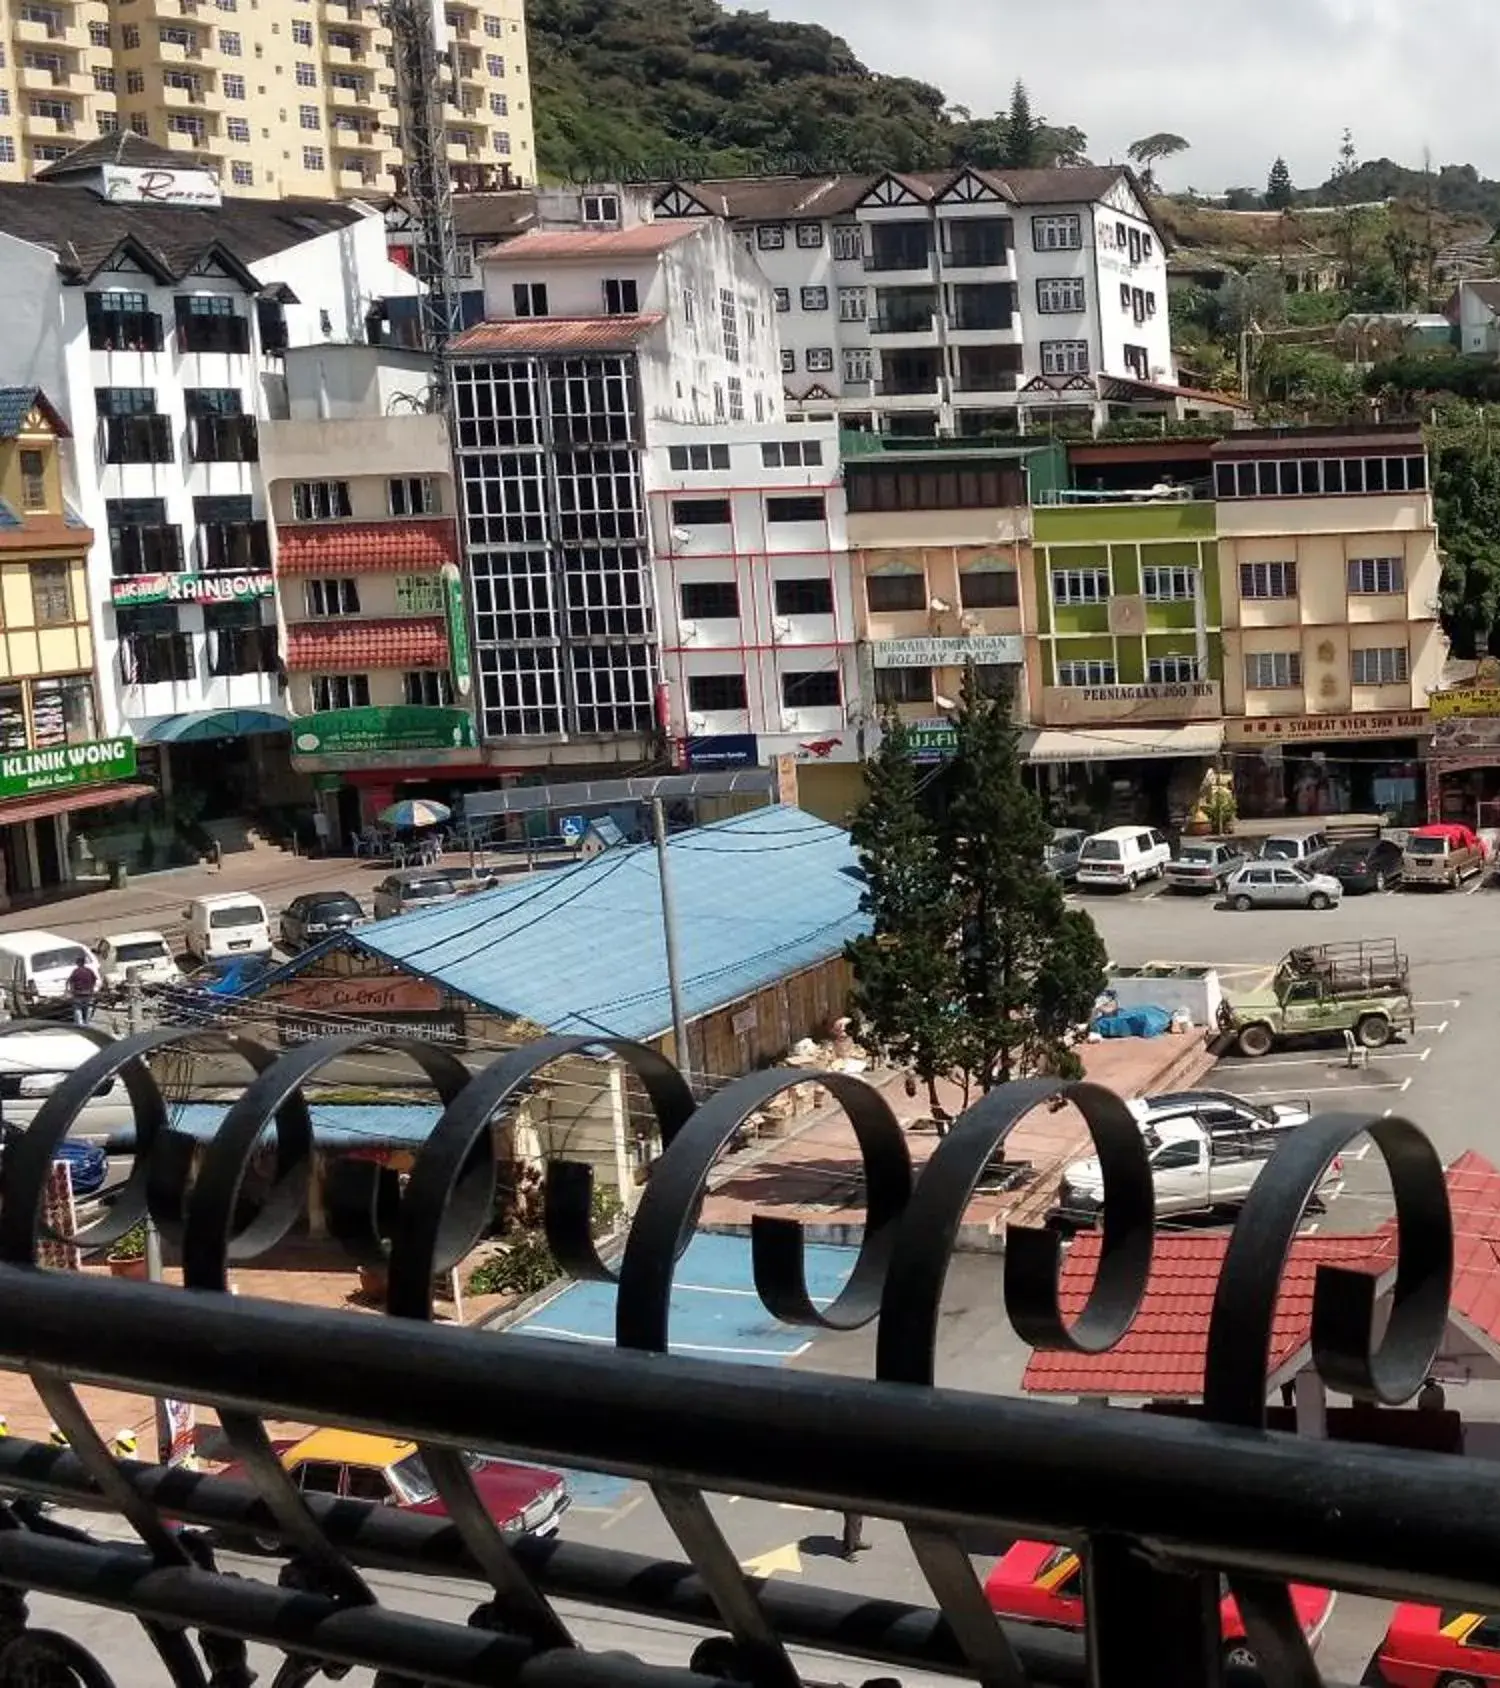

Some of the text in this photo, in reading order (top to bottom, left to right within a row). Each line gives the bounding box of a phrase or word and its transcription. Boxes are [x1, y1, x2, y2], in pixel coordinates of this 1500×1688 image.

[168, 575, 268, 600] RAINBOW
[887, 652, 947, 666] HOLIDAY
[2, 749, 67, 778] KLINIK
[67, 740, 127, 767] WONG
